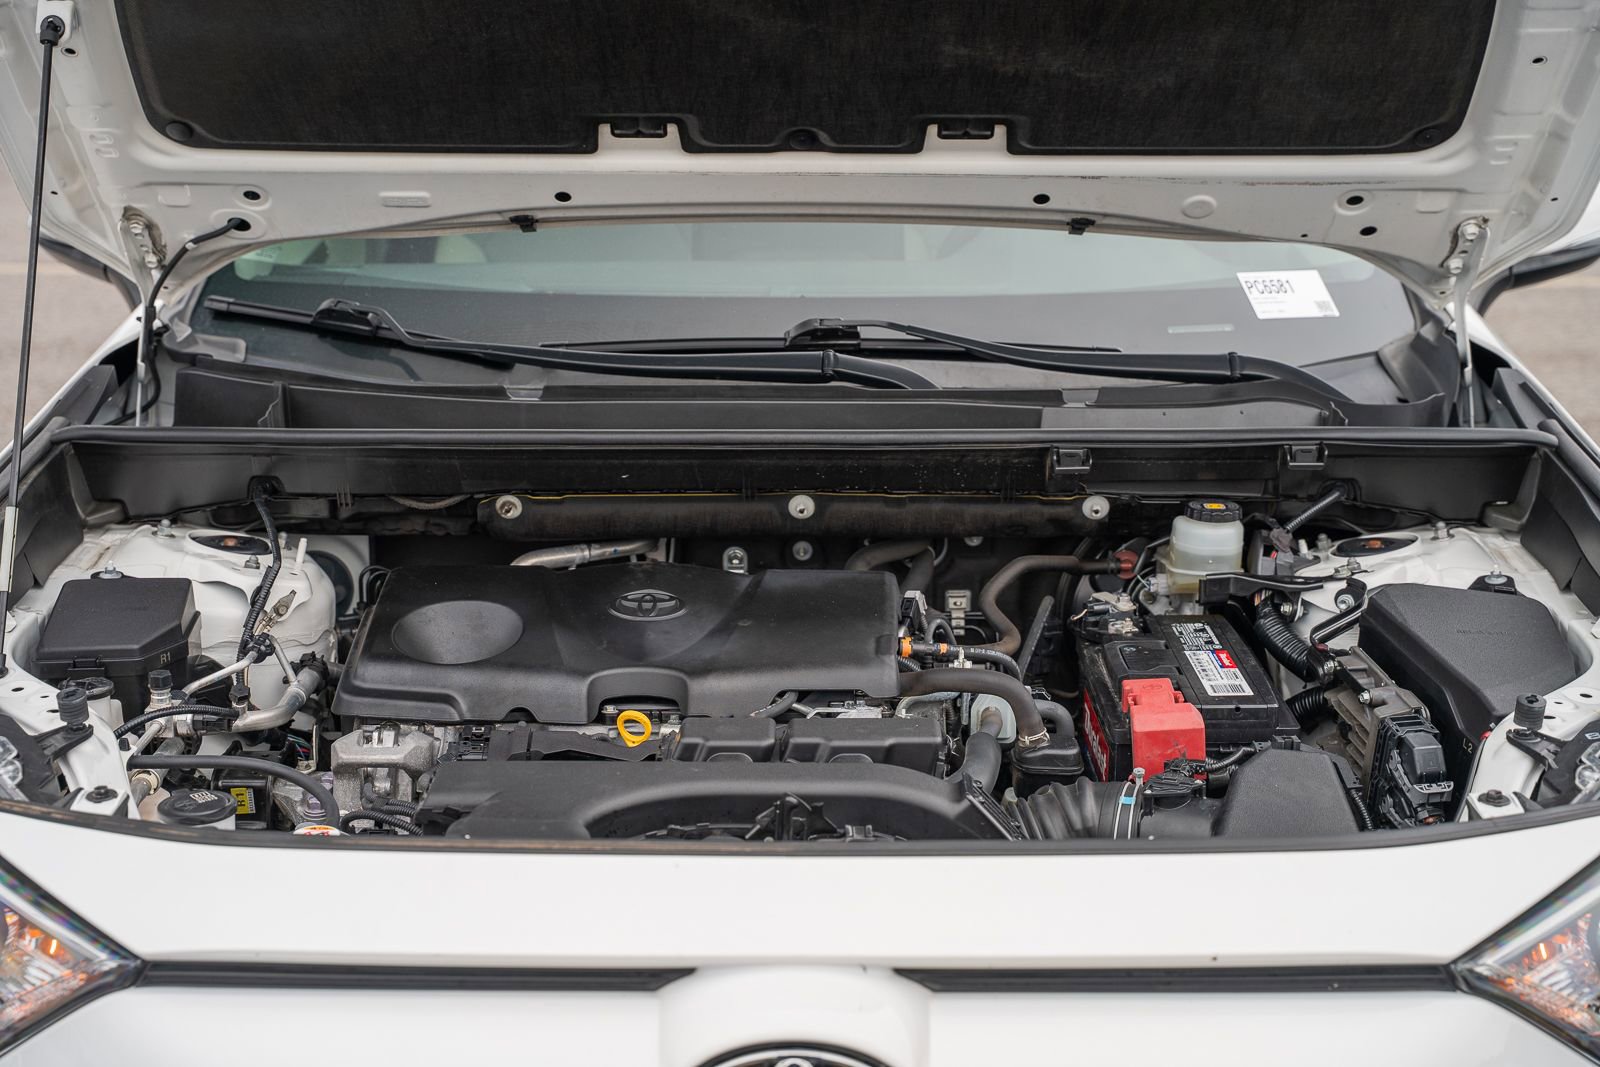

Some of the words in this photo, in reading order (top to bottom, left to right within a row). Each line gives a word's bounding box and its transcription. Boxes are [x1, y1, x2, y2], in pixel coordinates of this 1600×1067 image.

[1244, 279, 1296, 295] PC6581
[160, 651, 171, 665] R1
[235, 792, 246, 807] R1
